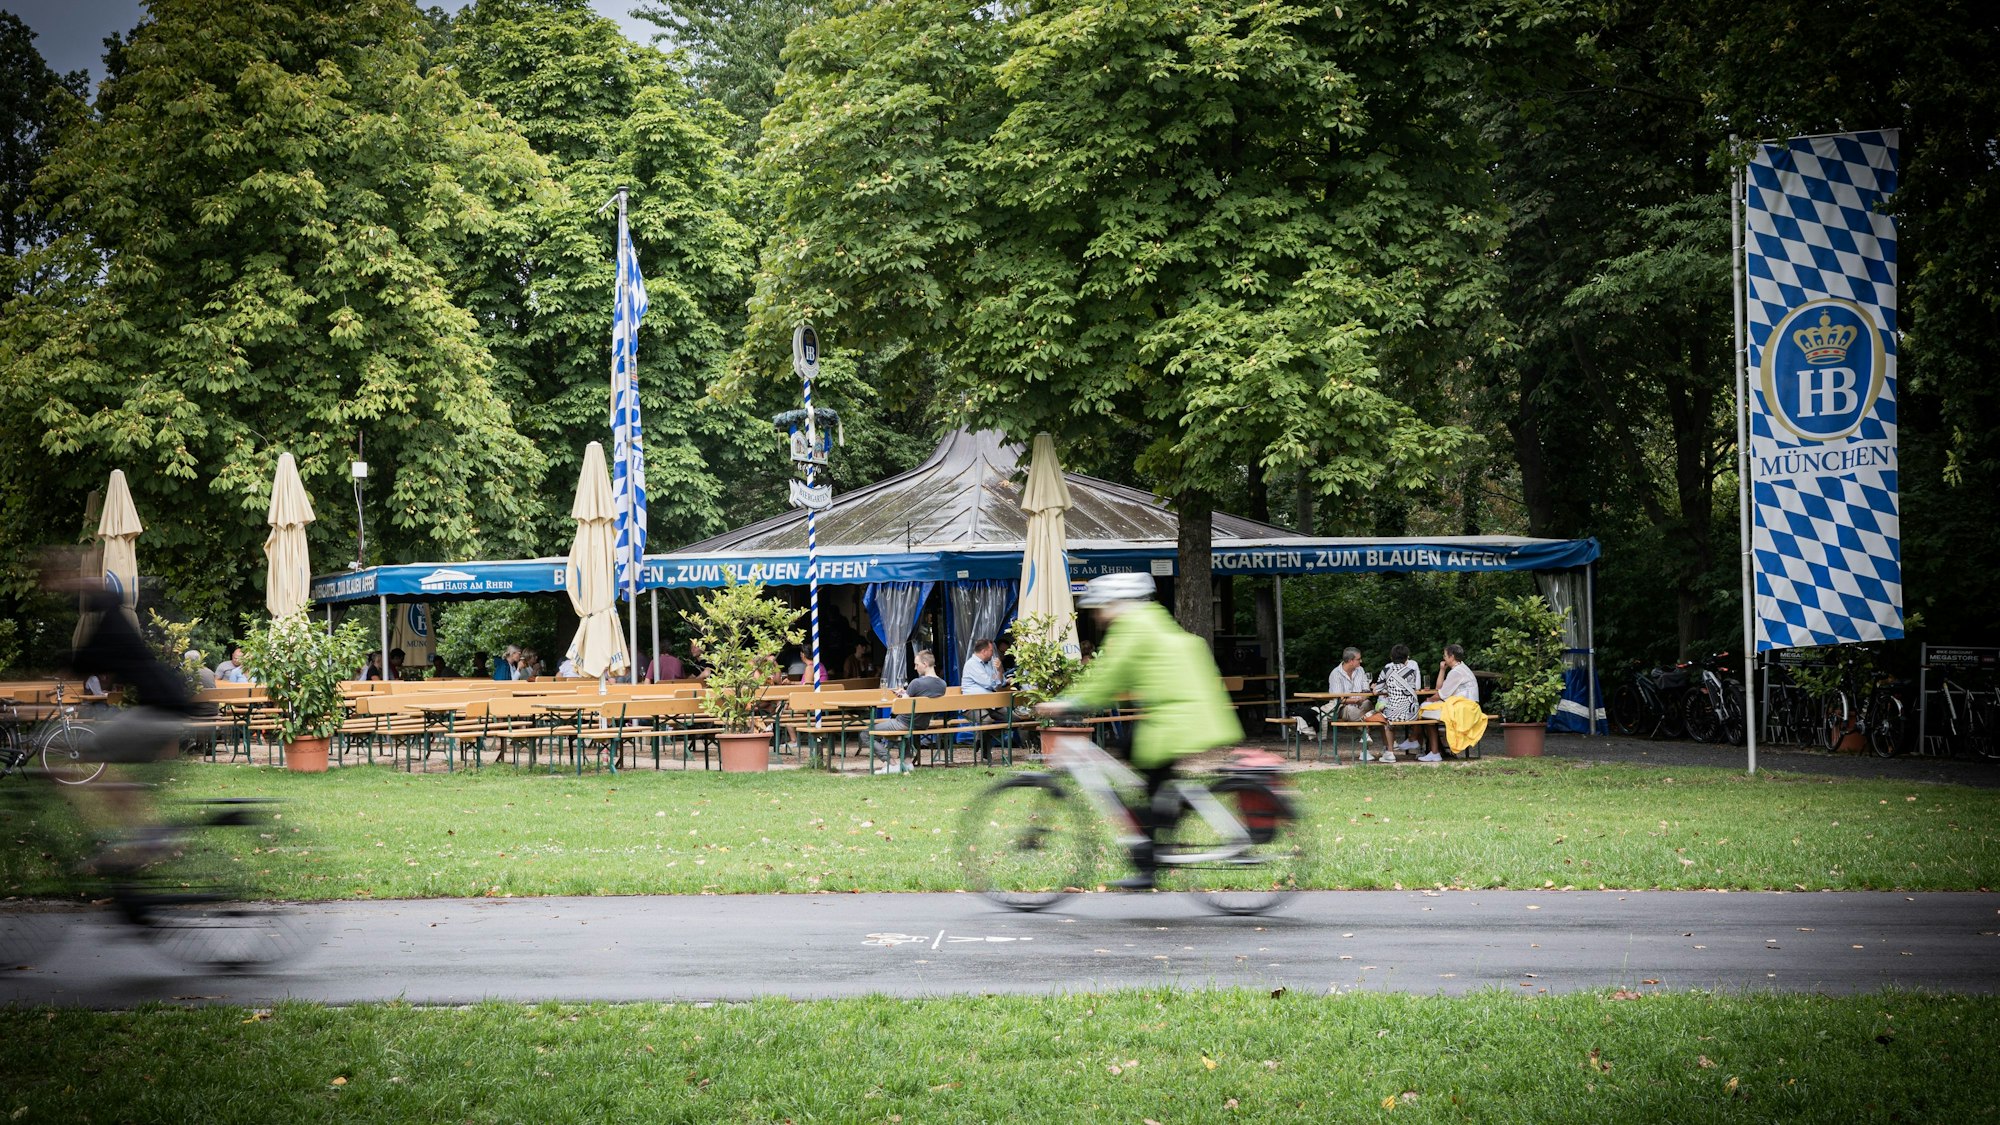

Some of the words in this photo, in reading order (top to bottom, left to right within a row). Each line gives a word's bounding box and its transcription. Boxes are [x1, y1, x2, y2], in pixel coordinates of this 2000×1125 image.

[805, 345, 815, 361] HB
[1796, 366, 1859, 418] HB
[1760, 446, 1890, 477] MÜNCHEN
[1211, 551, 1301, 569] RGARTEN
[1366, 549, 1442, 566] BLAUEN
[1929, 654, 1980, 662] MEGASTORE
